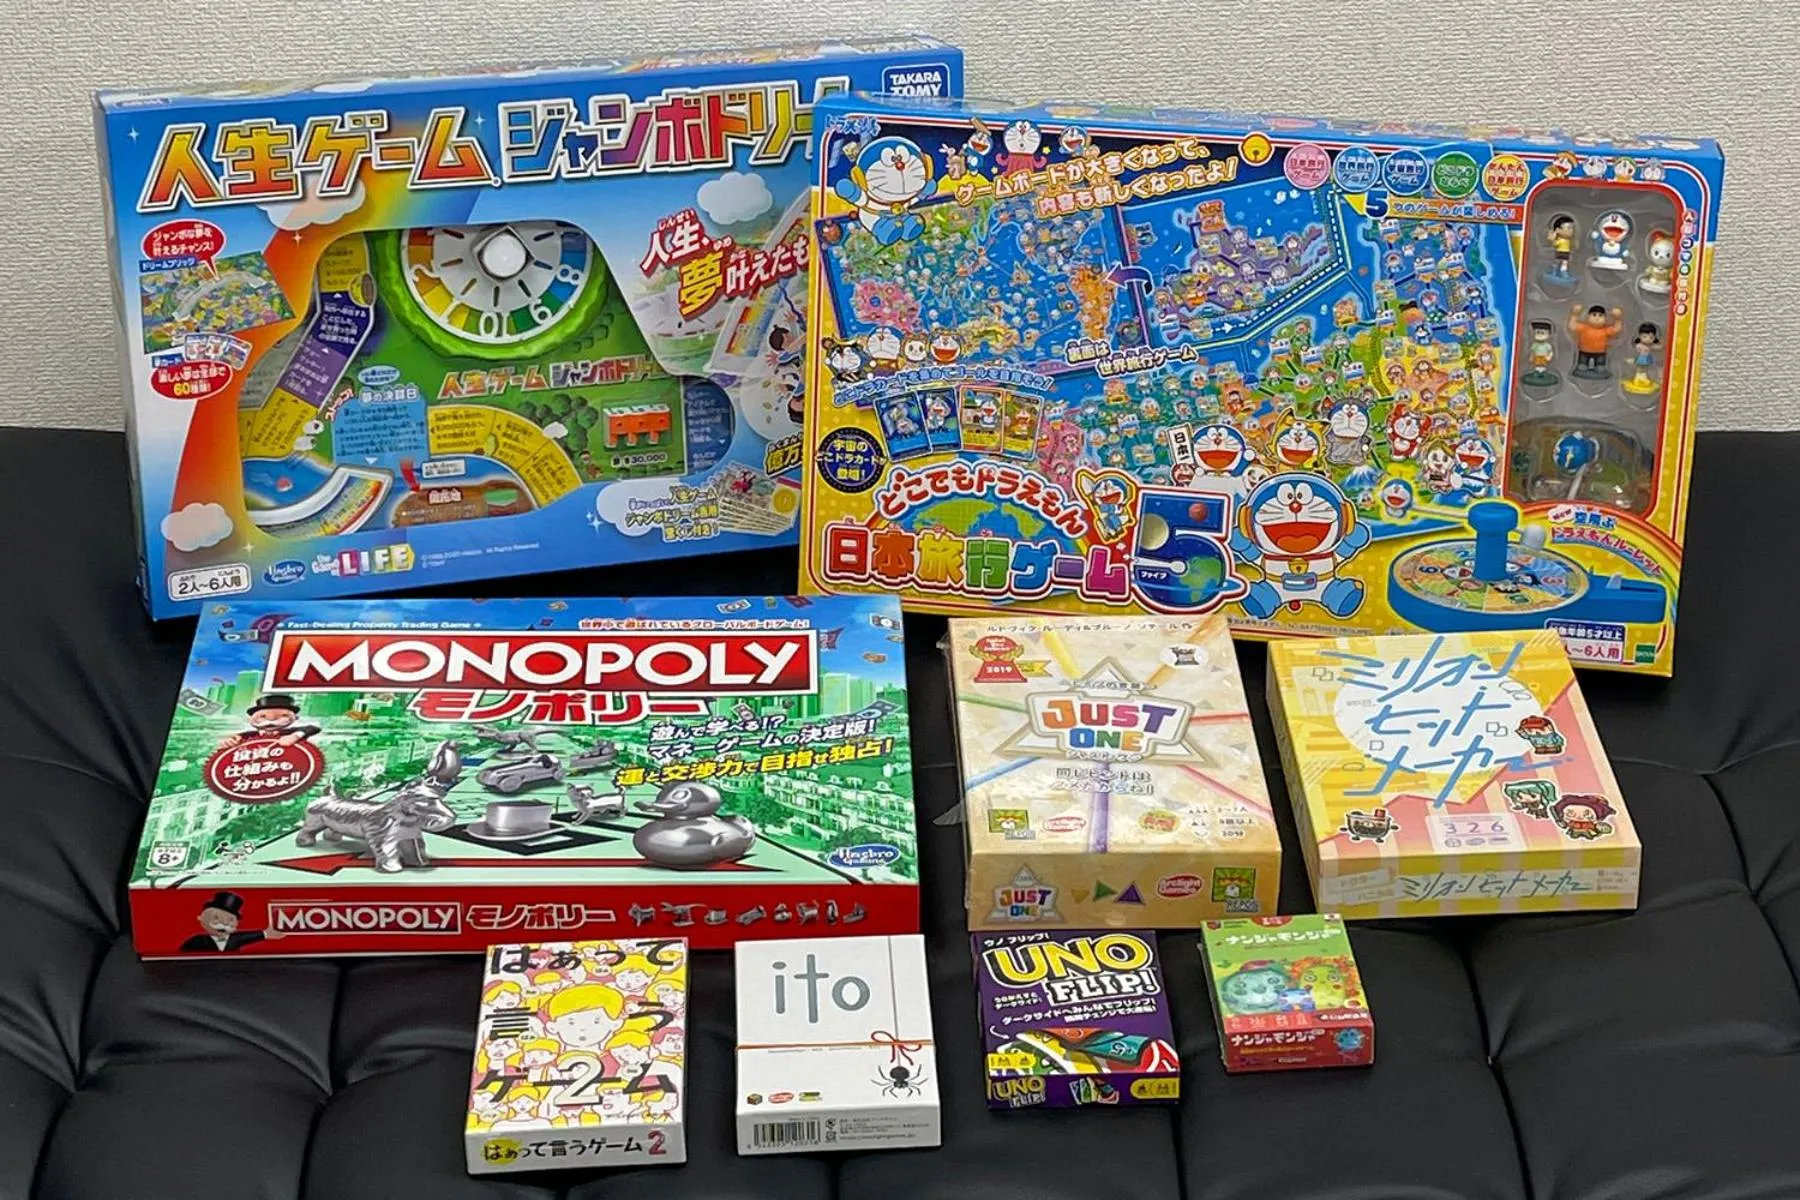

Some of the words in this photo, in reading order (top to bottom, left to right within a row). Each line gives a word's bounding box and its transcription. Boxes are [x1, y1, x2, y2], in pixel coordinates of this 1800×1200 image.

[889, 71, 942, 86] TAKARA
[889, 83, 942, 97] TOMY
[138, 107, 500, 212] 人生ゲーム
[499, 76, 850, 182] ジャンボドリー
[957, 138, 1210, 205] ゲームボードが大きくなって、
[438, 366, 549, 400] 人生ゲーム
[877, 465, 1087, 537] どこでもドラえもん
[341, 545, 410, 575] LIFE
[827, 524, 1127, 596] 日本旅行ゲーム
[1136, 491, 1229, 607] 5
[288, 639, 801, 685] MONOPOLY
[1319, 635, 1525, 701] ミリオン
[412, 690, 709, 725] モノポリー
[1042, 699, 1177, 734] JUST
[1364, 685, 1512, 747] ヒット
[648, 719, 876, 758] マネーゲームの決定版!
[1069, 728, 1146, 751] ONE
[617, 739, 893, 786] 運と交渉力で目指せ独占!
[1444, 822, 1458, 834] 3
[1467, 822, 1480, 833] 2
[1491, 821, 1505, 833] 6
[999, 888, 1051, 906] JUST
[1010, 904, 1039, 917] ONE
[275, 905, 455, 932] MONOPOLY
[466, 904, 616, 931] モノポリー
[990, 934, 1151, 984] UNO
[772, 954, 871, 1023] ito
[1050, 970, 1157, 1002] FLIP!
[553, 1055, 606, 1107] 2
[995, 1077, 1044, 1098] UNO
